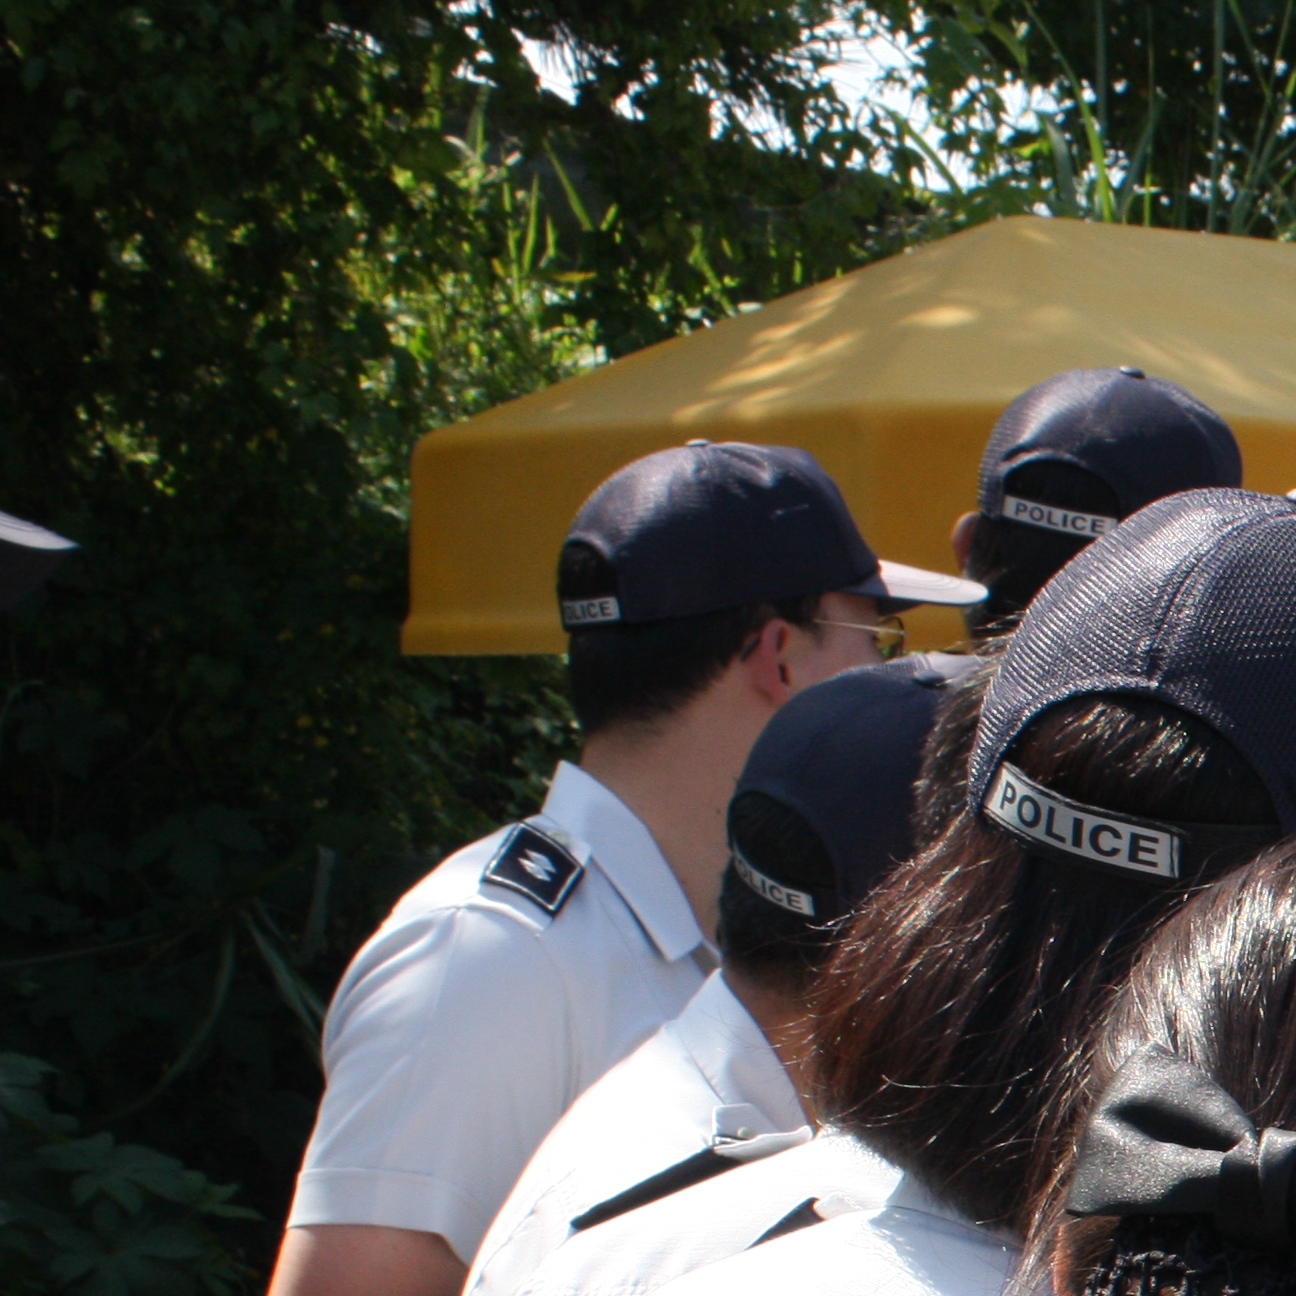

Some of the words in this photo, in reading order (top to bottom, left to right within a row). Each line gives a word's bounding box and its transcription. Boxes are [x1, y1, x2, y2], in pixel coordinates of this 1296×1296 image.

[1014, 502, 1105, 534] POLICE
[1000, 780, 1160, 868] POLICE
[735, 860, 804, 911] OLICE
